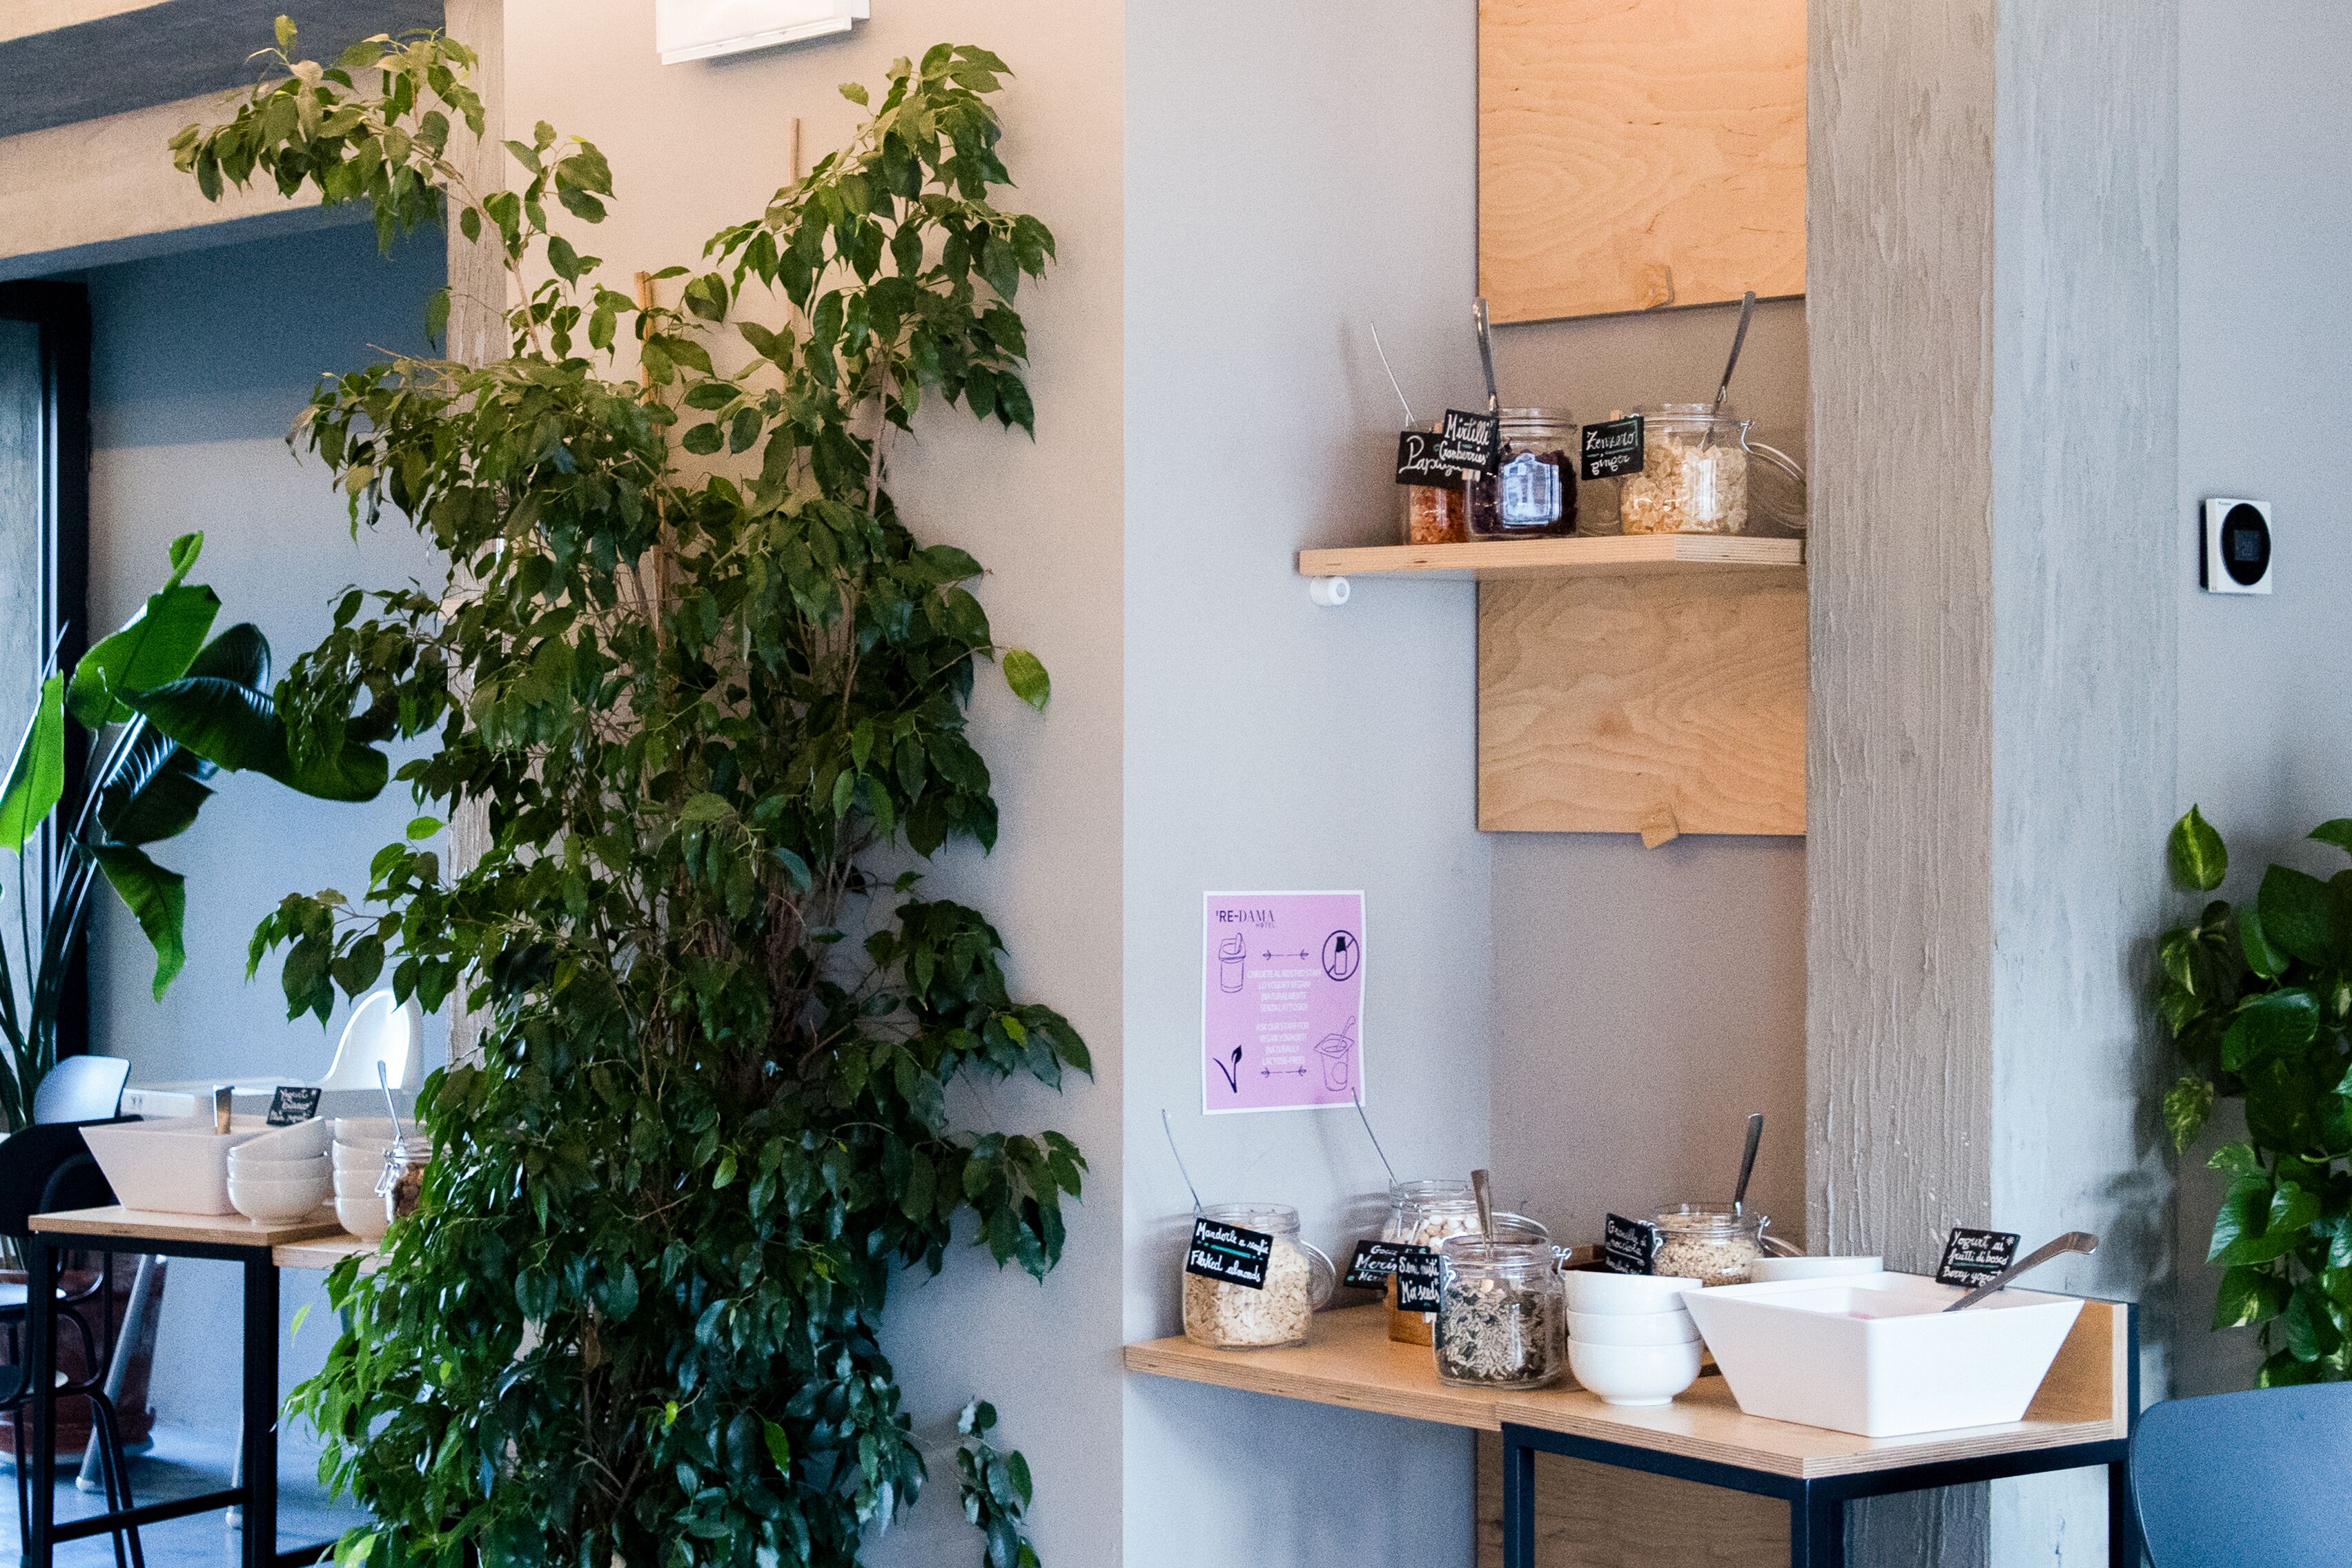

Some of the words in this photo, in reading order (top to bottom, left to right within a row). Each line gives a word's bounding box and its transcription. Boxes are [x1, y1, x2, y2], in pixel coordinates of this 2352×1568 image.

[1444, 414, 1489, 445] Mirtilli
[1586, 431, 1636, 450] Zenzero
[1439, 440, 1487, 465] Cranberries
[1590, 453, 1629, 476] ginger
[1195, 1222, 1237, 1244] Mandorle
[1951, 1231, 1992, 1249] Yogurt
[1991, 1237, 2005, 1251] ai
[1948, 1248, 1975, 1264] frutti
[1976, 1251, 1986, 1262] di
[1986, 1251, 2009, 1265] bosco
[1225, 1260, 1261, 1282] almonds
[1943, 1266, 1970, 1282] Berry
[1402, 1280, 1416, 1304] Mix
